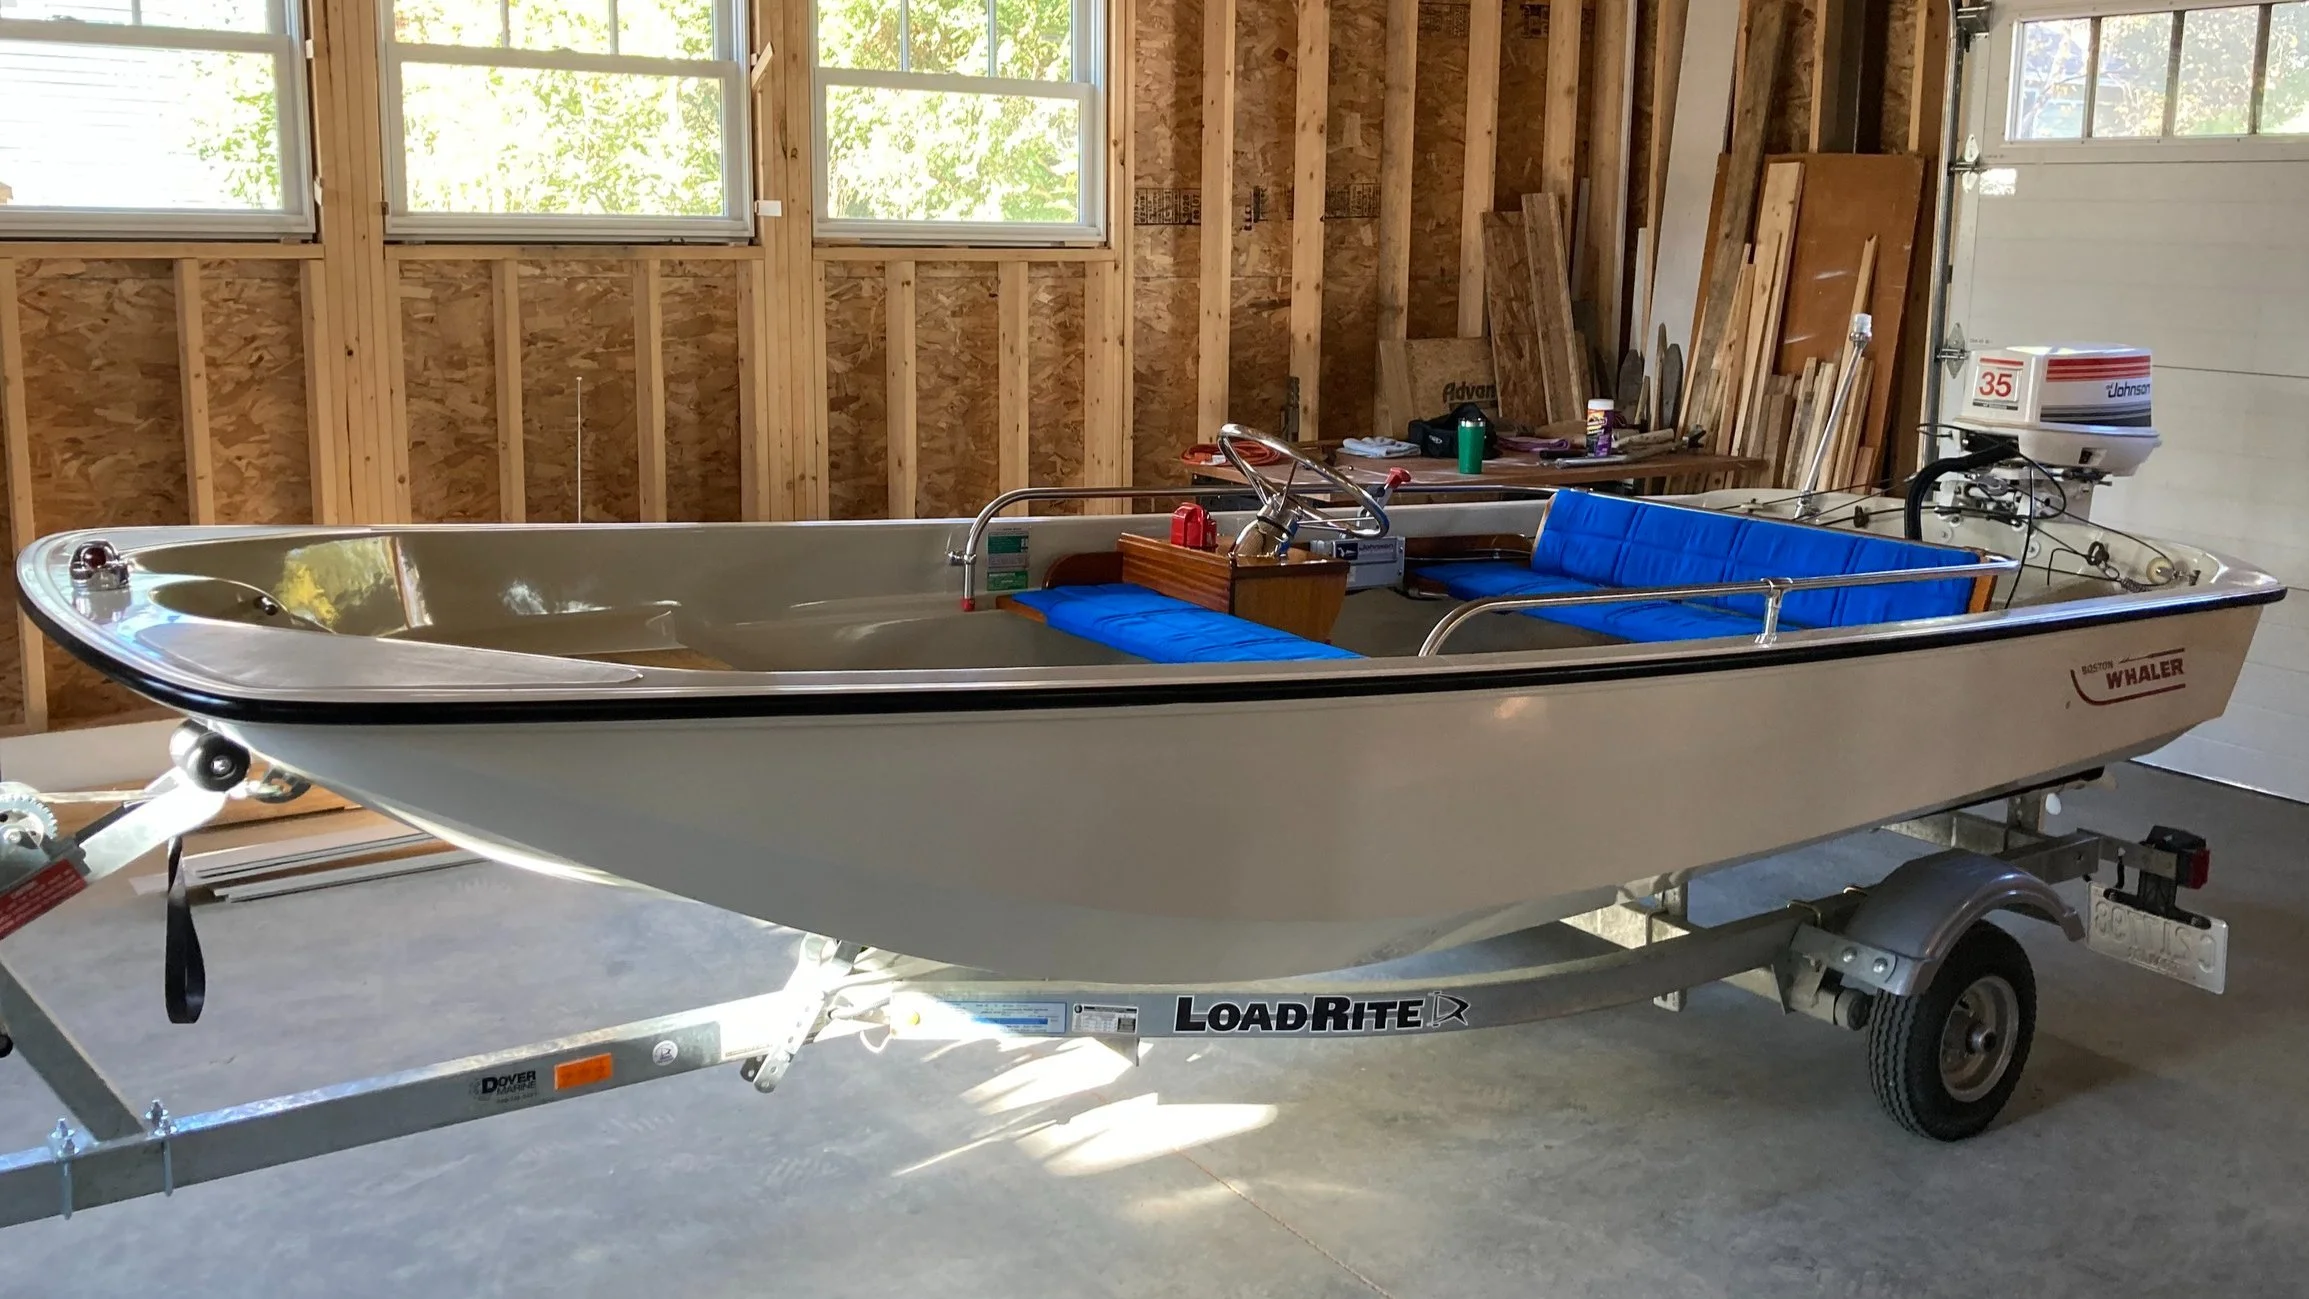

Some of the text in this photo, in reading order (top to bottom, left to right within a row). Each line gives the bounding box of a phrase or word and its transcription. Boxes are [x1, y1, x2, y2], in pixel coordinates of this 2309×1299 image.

[1979, 370, 2013, 398] 35
[2107, 381, 2151, 399] Johnson
[2081, 660, 2114, 675] BOSTON
[2106, 658, 2184, 690] WHALER
[482, 1070, 537, 1094] DOVER
[496, 1081, 537, 1095] MARINE
